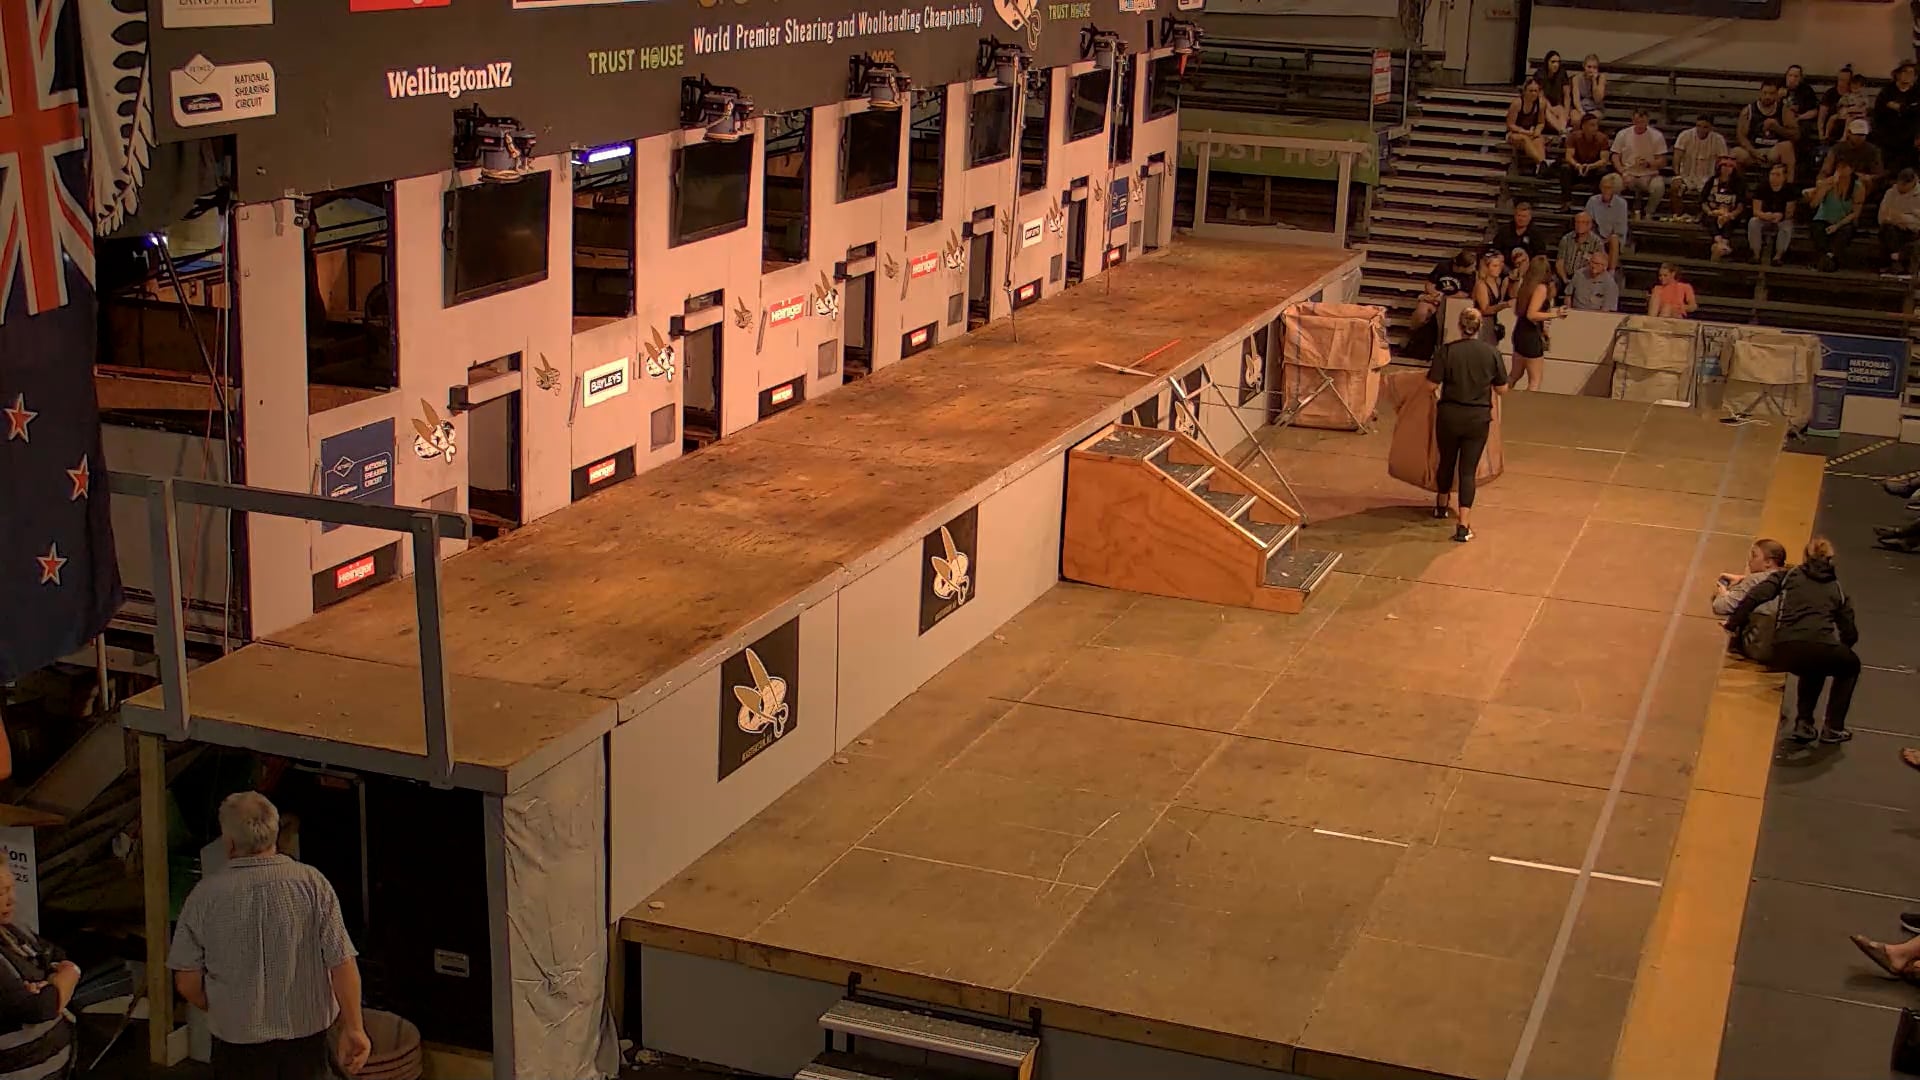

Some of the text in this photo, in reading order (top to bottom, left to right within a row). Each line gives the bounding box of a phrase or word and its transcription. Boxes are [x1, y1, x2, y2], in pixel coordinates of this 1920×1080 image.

[1049, 4, 1070, 20] TRUST
[694, 4, 984, 54] World Premier Shearing and Woolhandling Championship
[588, 44, 684, 75] TRUST HOUSE
[234, 72, 270, 84] NATIONAL
[387, 62, 513, 99] WellingtonNZ
[235, 84, 270, 97] SHEARING
[235, 97, 263, 109] CIRCUIT
[1849, 359, 1890, 370] NATIONAL
[590, 372, 622, 391] BAYLEYS
[1847, 375, 1880, 385] CIRCUIT
